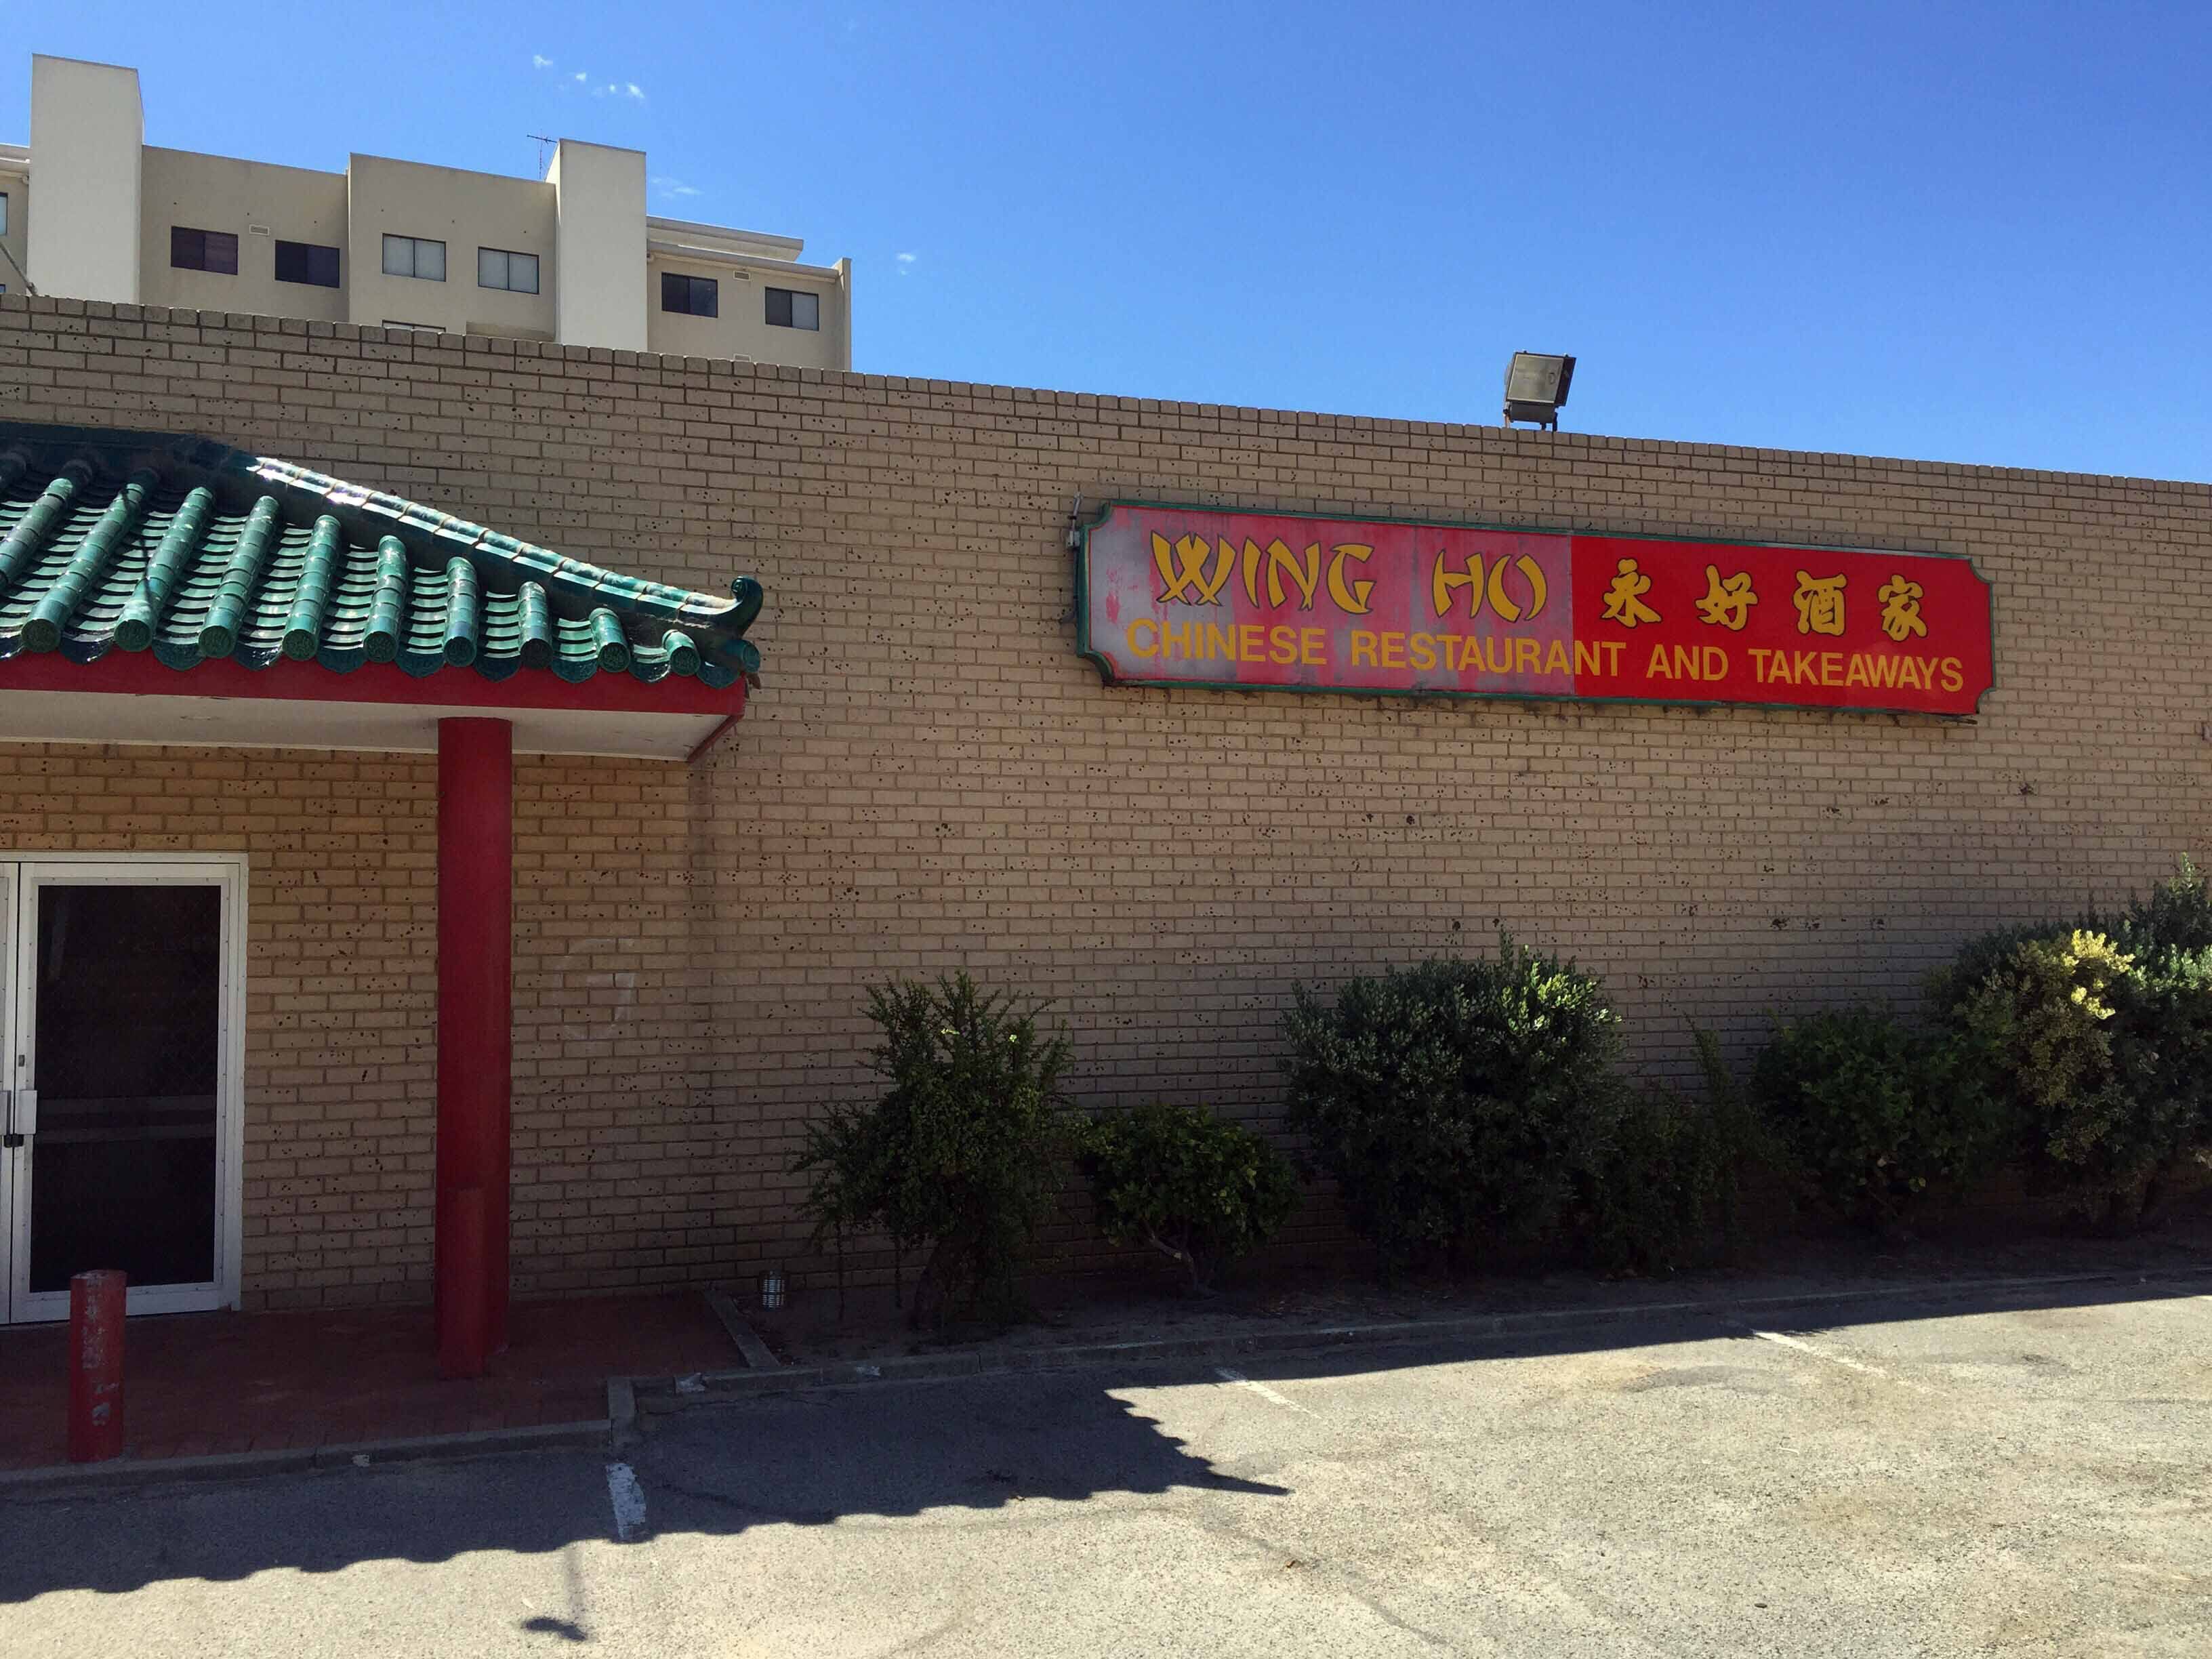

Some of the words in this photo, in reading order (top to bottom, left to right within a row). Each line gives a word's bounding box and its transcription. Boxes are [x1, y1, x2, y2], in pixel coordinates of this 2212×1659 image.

[1151, 530, 1376, 615] WING
[1431, 550, 1548, 623] HO
[1601, 557, 1928, 642] 永好酒家
[1128, 618, 1327, 665] CHINESE
[1351, 631, 1627, 676] RESTAURANT
[1646, 644, 1729, 681] AND
[1748, 648, 1964, 692] TAKEAWAYS
